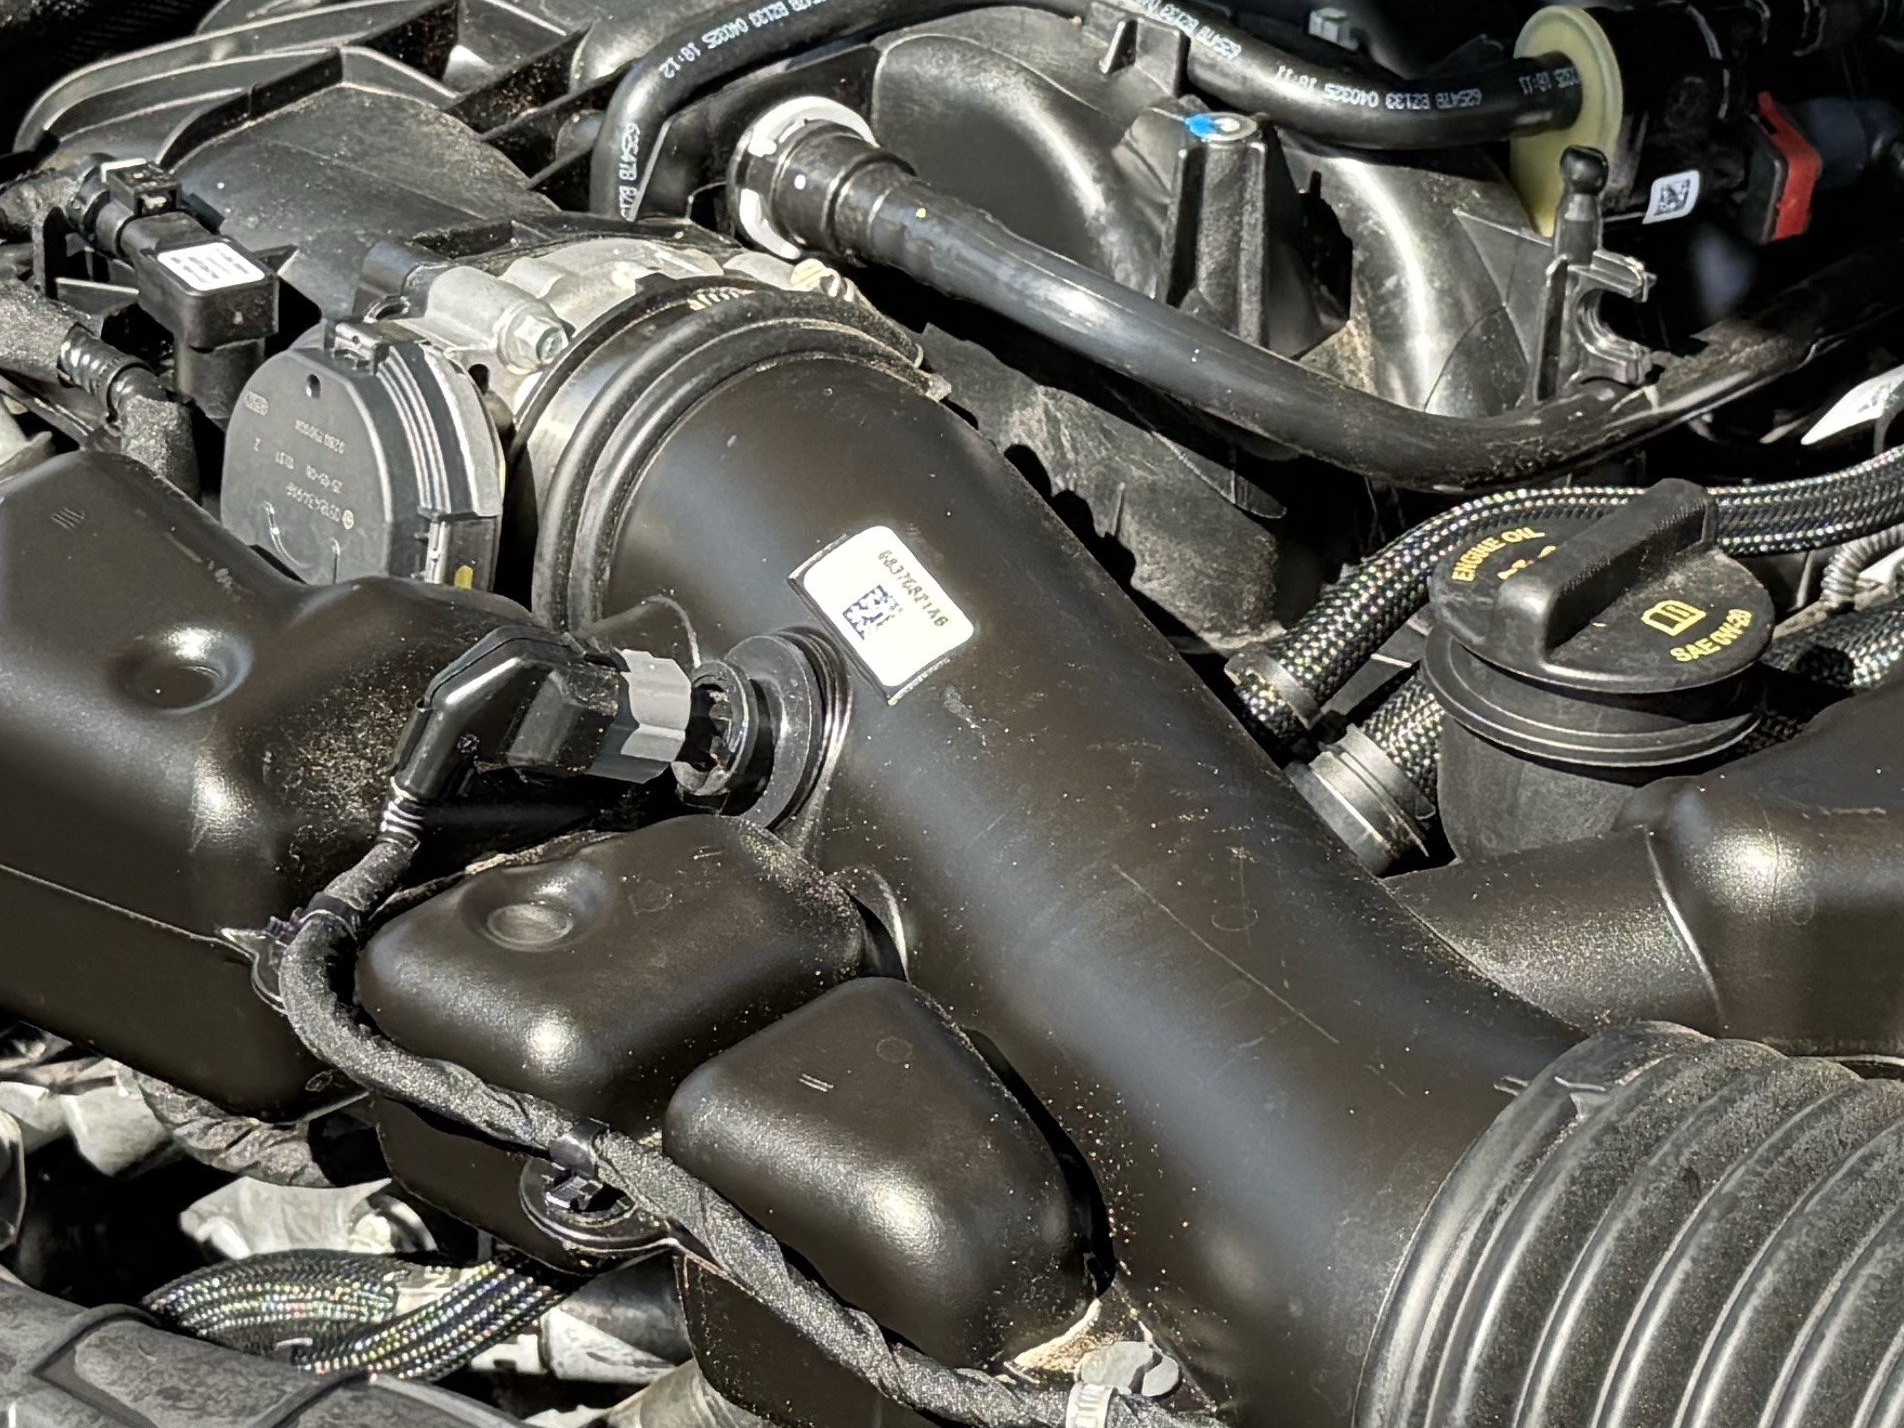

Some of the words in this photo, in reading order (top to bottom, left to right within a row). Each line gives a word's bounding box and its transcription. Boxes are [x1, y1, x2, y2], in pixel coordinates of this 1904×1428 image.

[660, 42, 701, 79] 18:12
[1324, 85, 1380, 109] 040325
[1452, 536, 1506, 582] ENGINE
[1502, 527, 1545, 543] OIL
[1669, 637, 1719, 662] SAE
